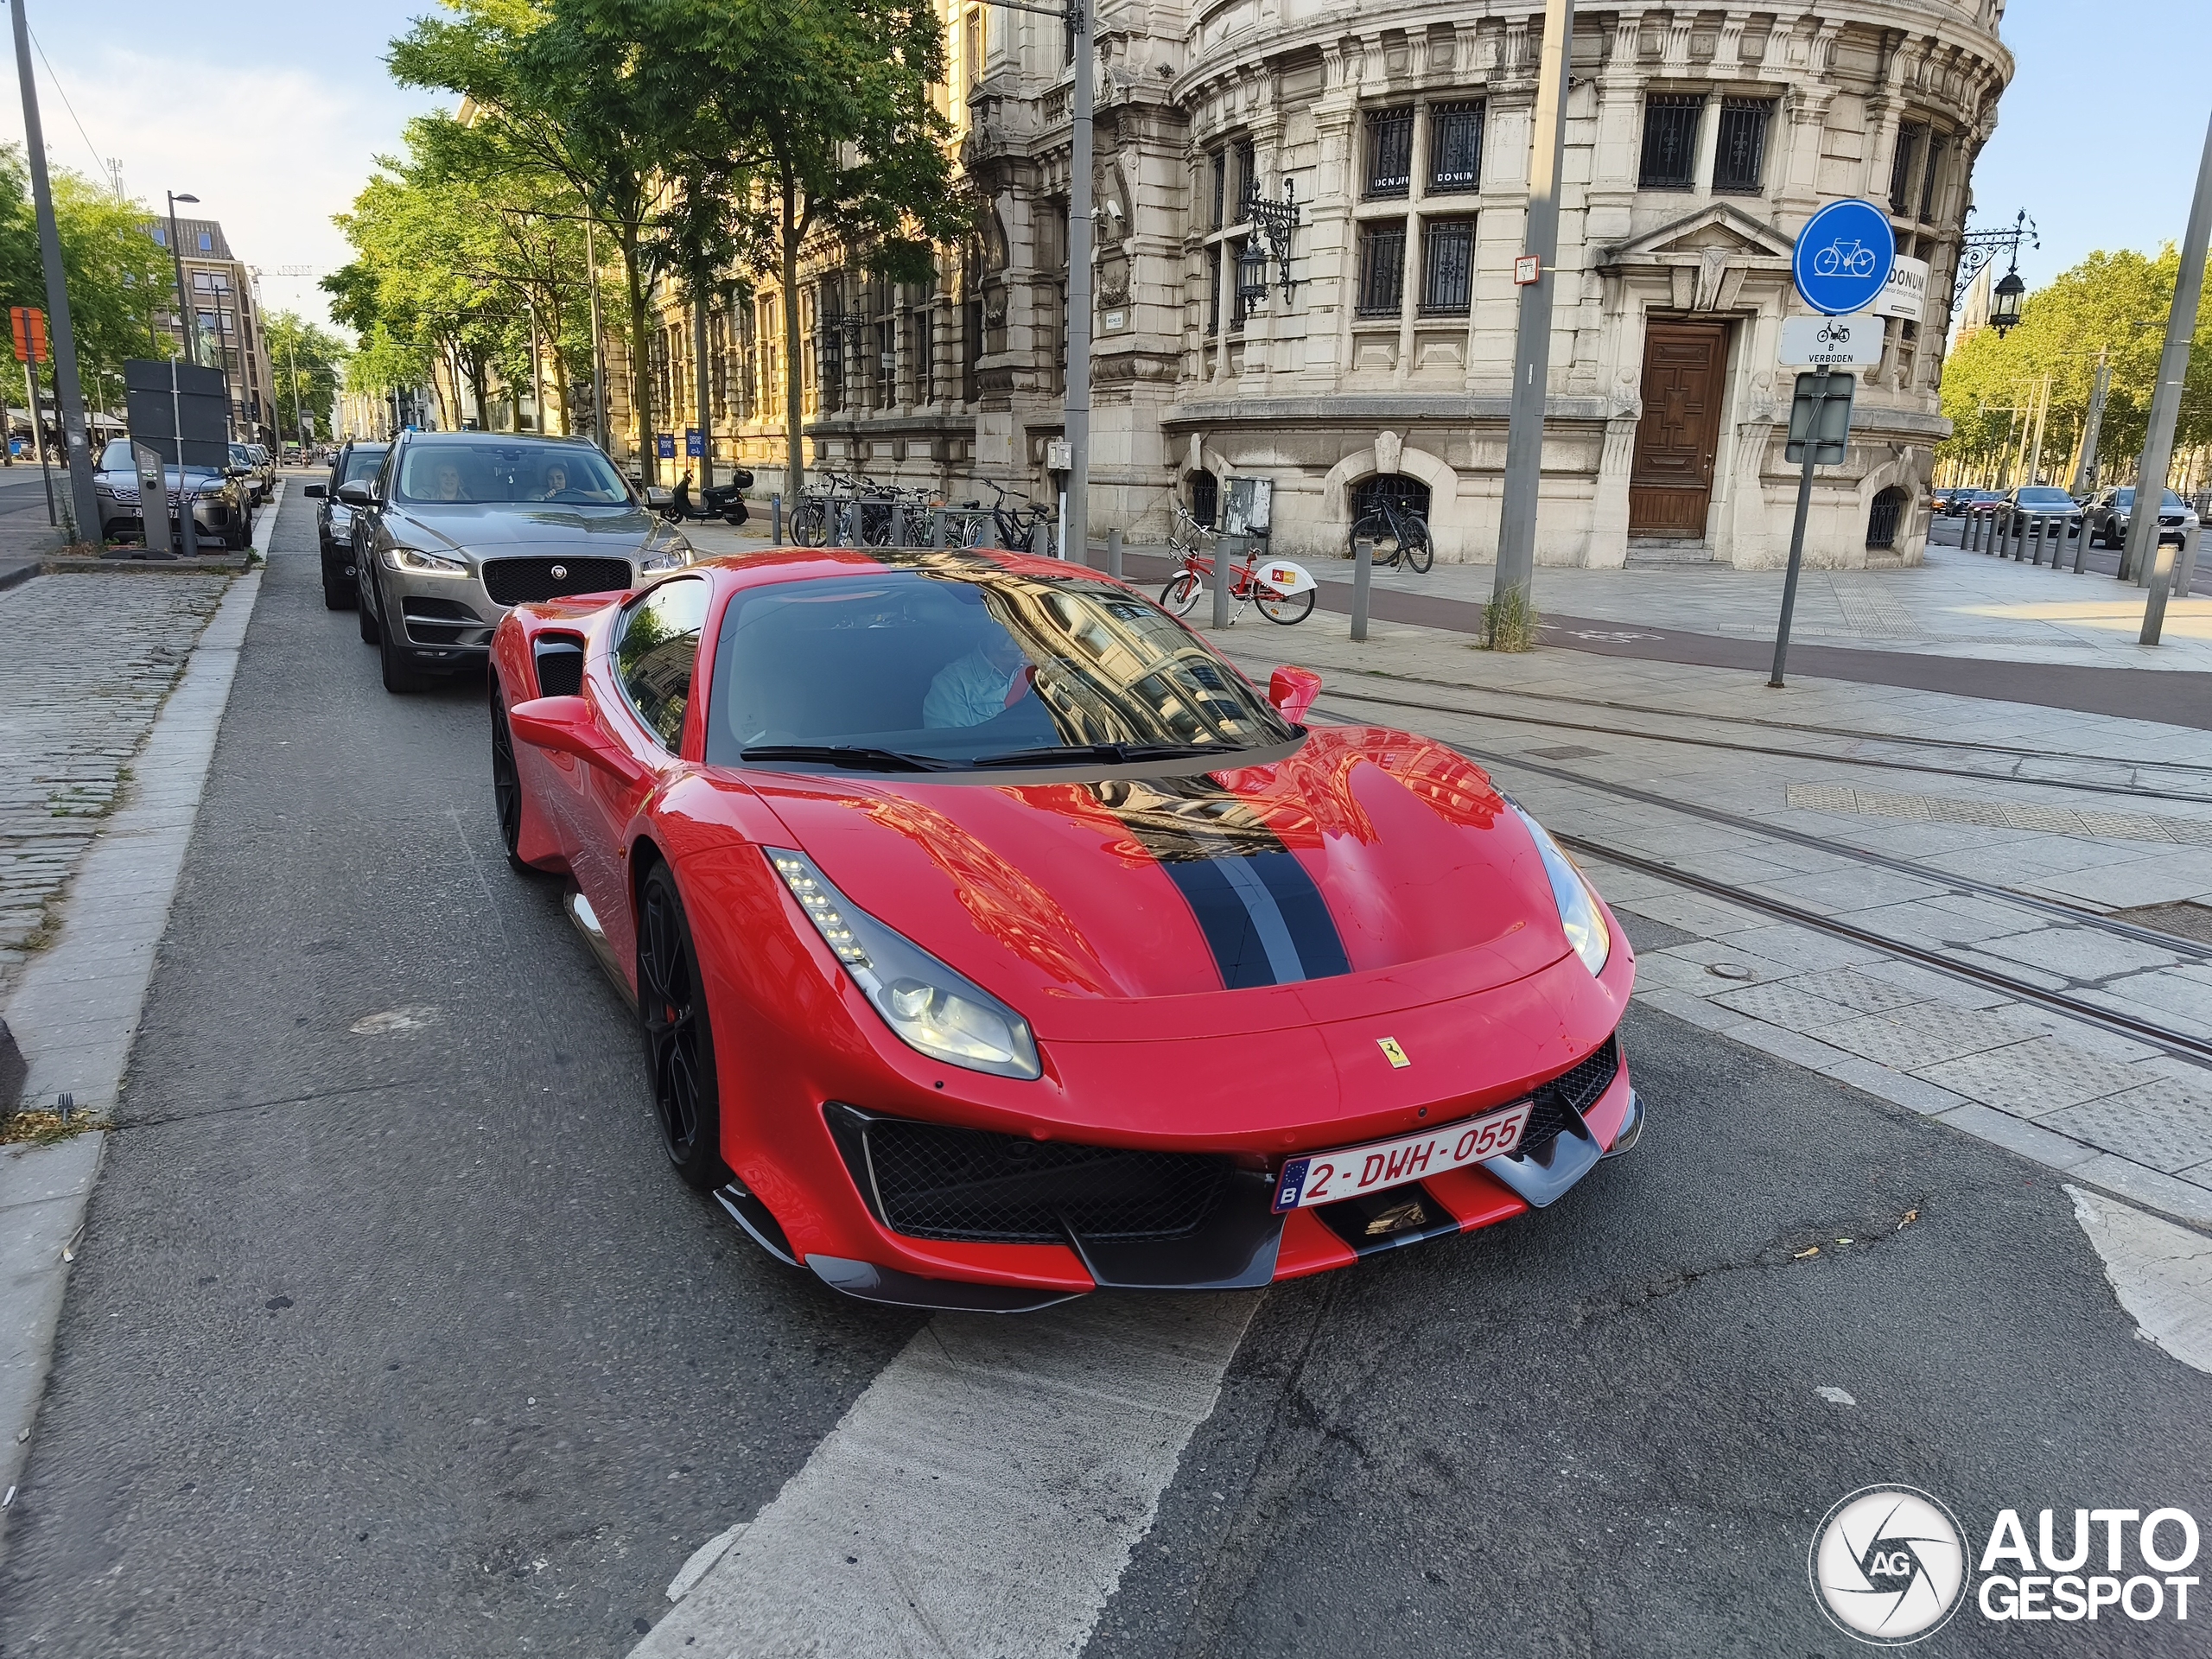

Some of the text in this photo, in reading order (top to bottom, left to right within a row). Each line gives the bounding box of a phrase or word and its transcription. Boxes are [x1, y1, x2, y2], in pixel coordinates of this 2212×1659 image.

[1437, 172, 1473, 181] DONUM
[1888, 268, 1924, 292] DONUM
[1896, 288, 1908, 297] design
[1828, 343, 1834, 352] B
[1808, 354, 1853, 363] VERBODEN
[1280, 1187, 1297, 1205] B
